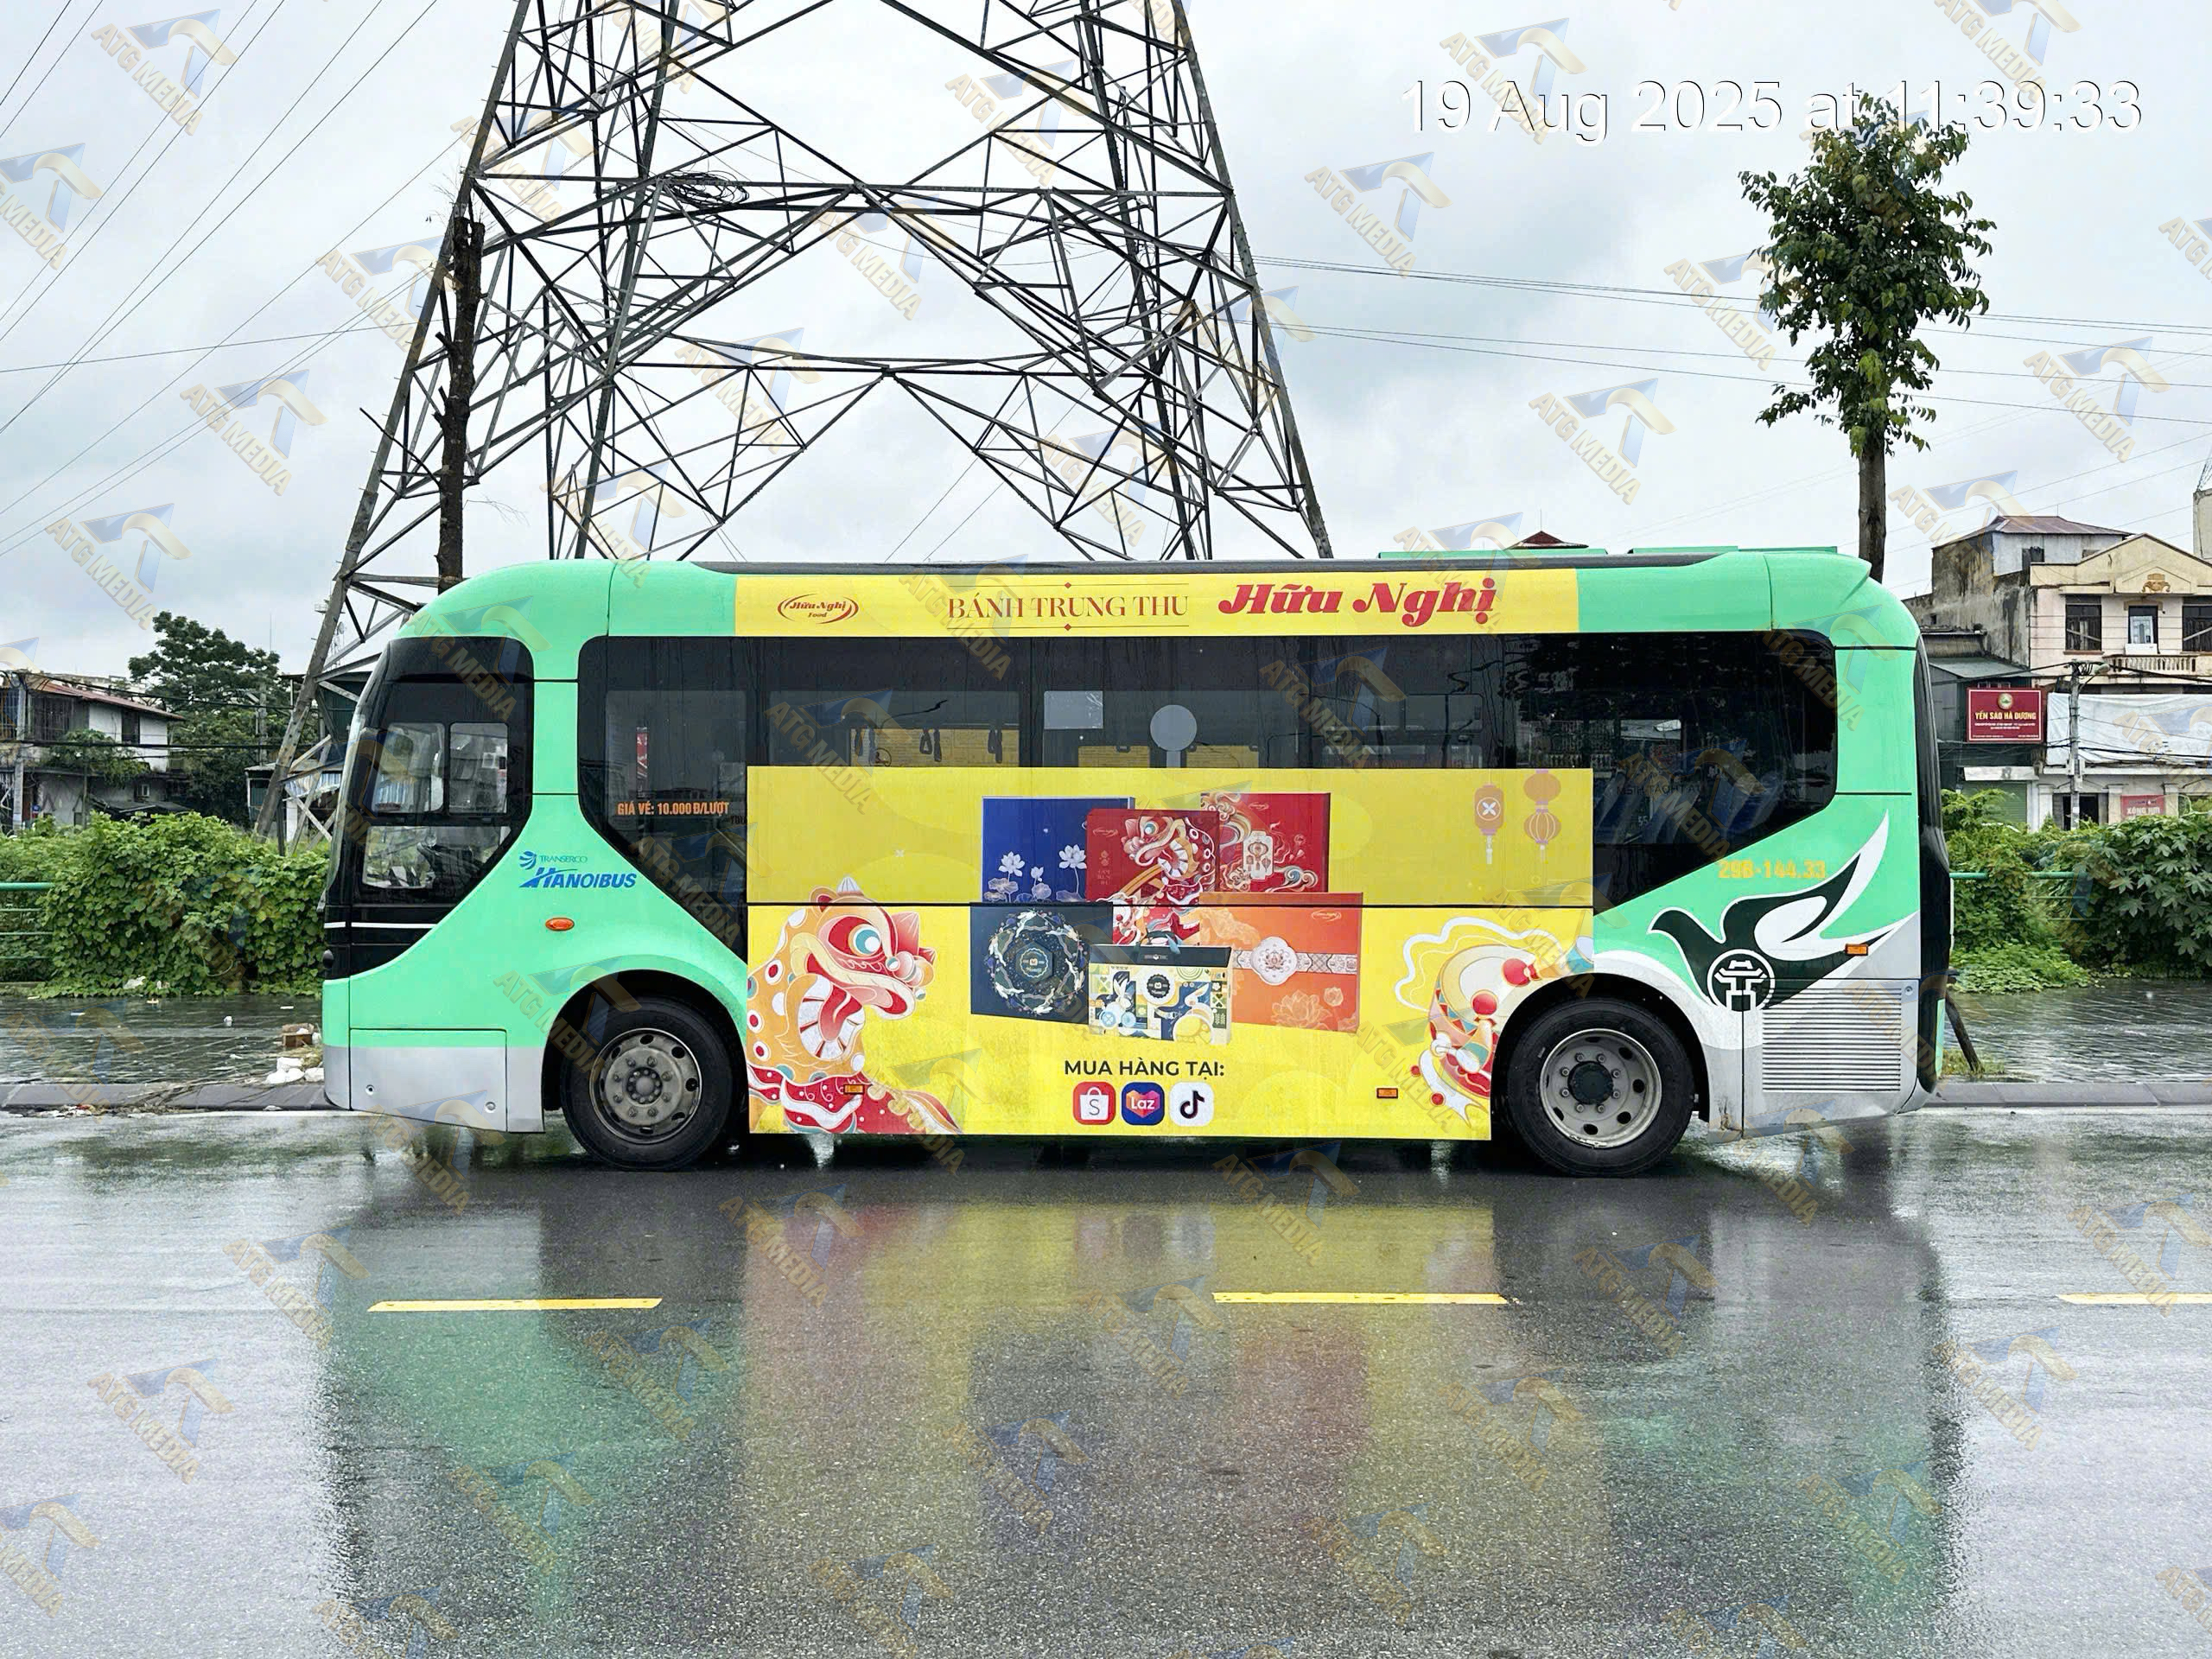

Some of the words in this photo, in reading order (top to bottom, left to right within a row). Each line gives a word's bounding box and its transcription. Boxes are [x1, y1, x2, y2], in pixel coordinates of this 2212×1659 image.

[949, 593, 1024, 619] BÁNH
[1030, 596, 1126, 618] TRUNG
[1133, 595, 1189, 617] THU
[1217, 583, 1344, 614] Hữu
[1352, 578, 1497, 627] Nghị
[617, 801, 636, 816] GIÁ
[638, 801, 655, 816] VÉ:
[521, 867, 638, 888] HANOIBUS
[1065, 1060, 1113, 1076] MUA
[1119, 1057, 1179, 1077] HÀNG
[1185, 1060, 1224, 1080] TẠI:
[1089, 1098, 1101, 1116] S
[1131, 1096, 1155, 1110] Laz
